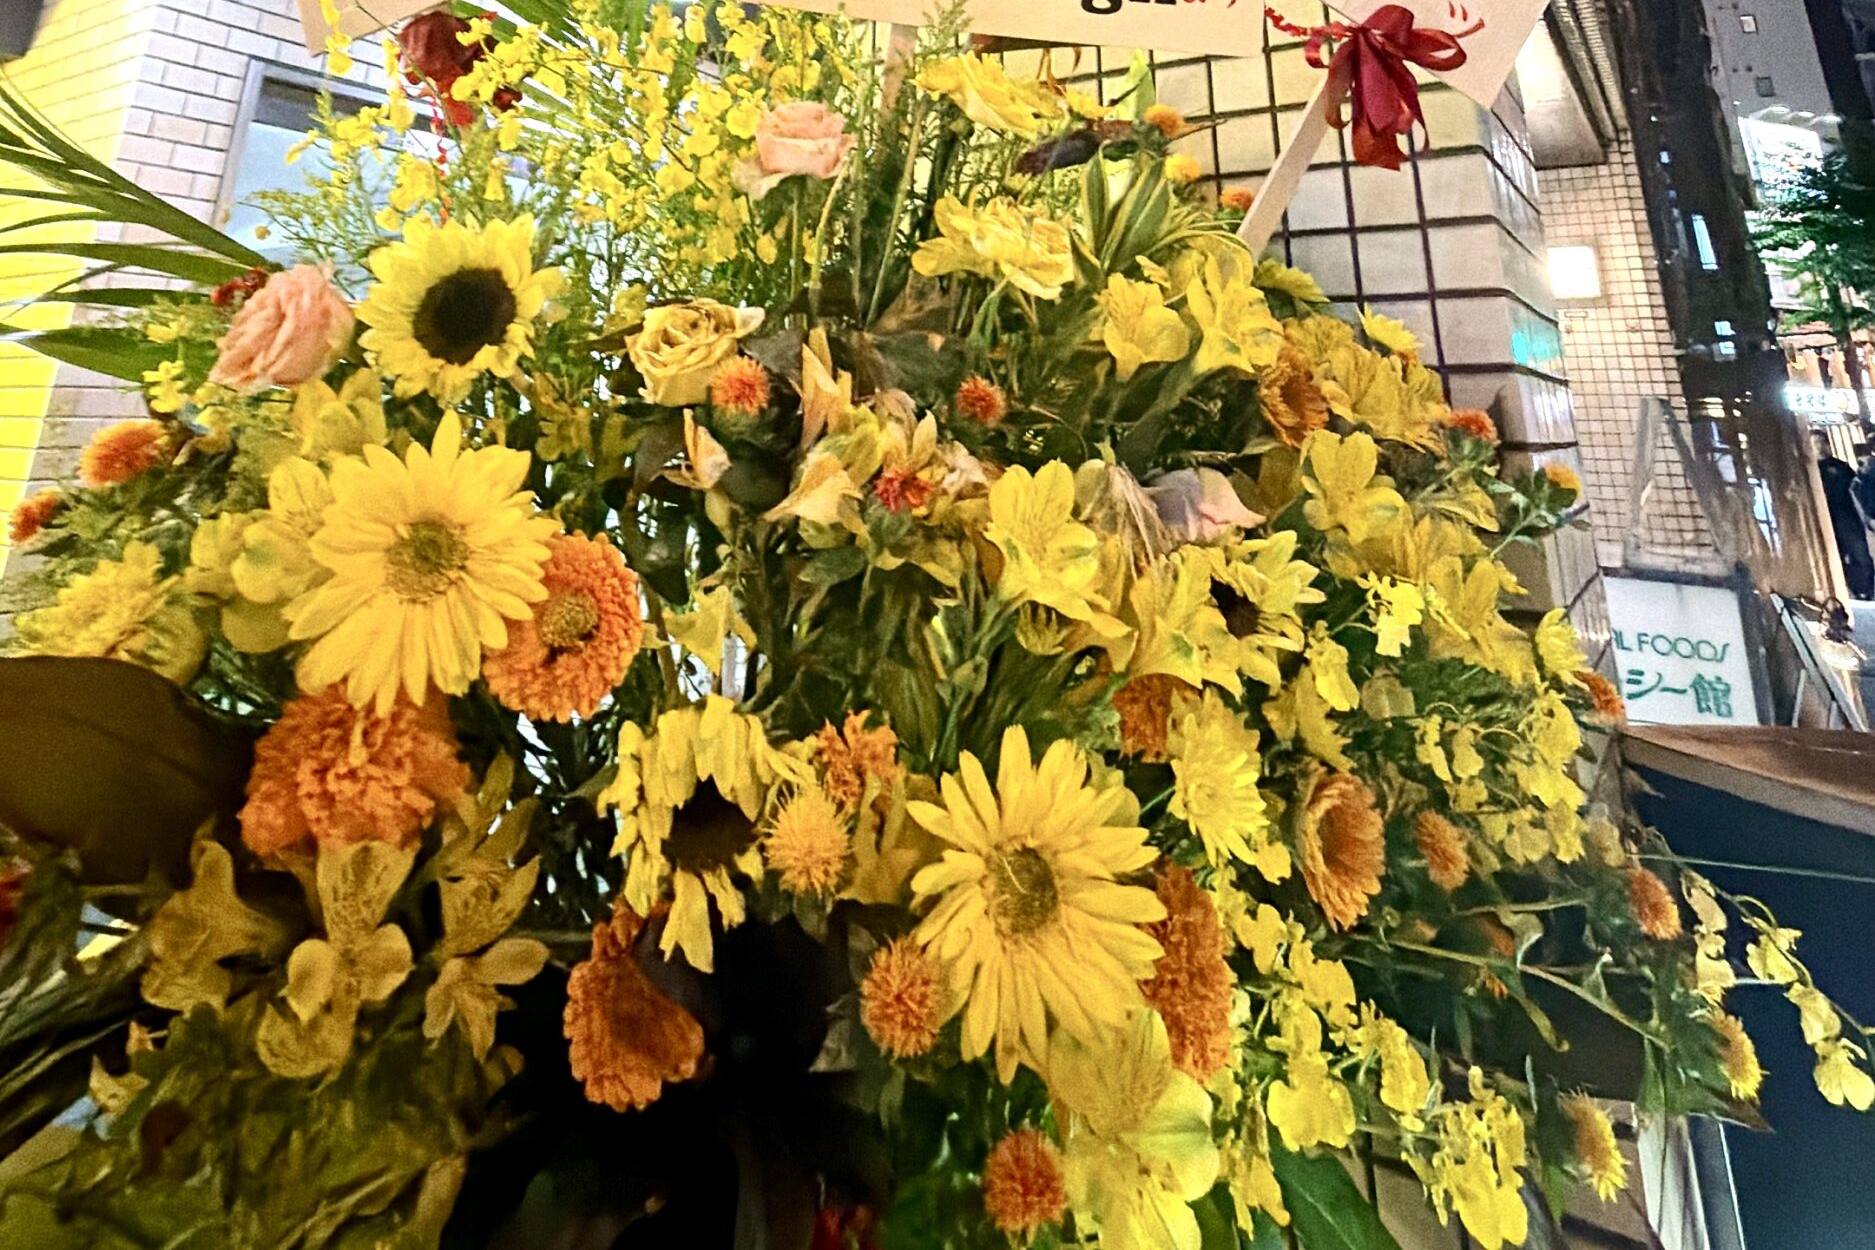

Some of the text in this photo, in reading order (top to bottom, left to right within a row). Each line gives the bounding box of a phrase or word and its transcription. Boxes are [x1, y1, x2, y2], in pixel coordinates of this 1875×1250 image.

[1637, 632, 1730, 662] FOODS
[1626, 668, 1732, 718] シー館
